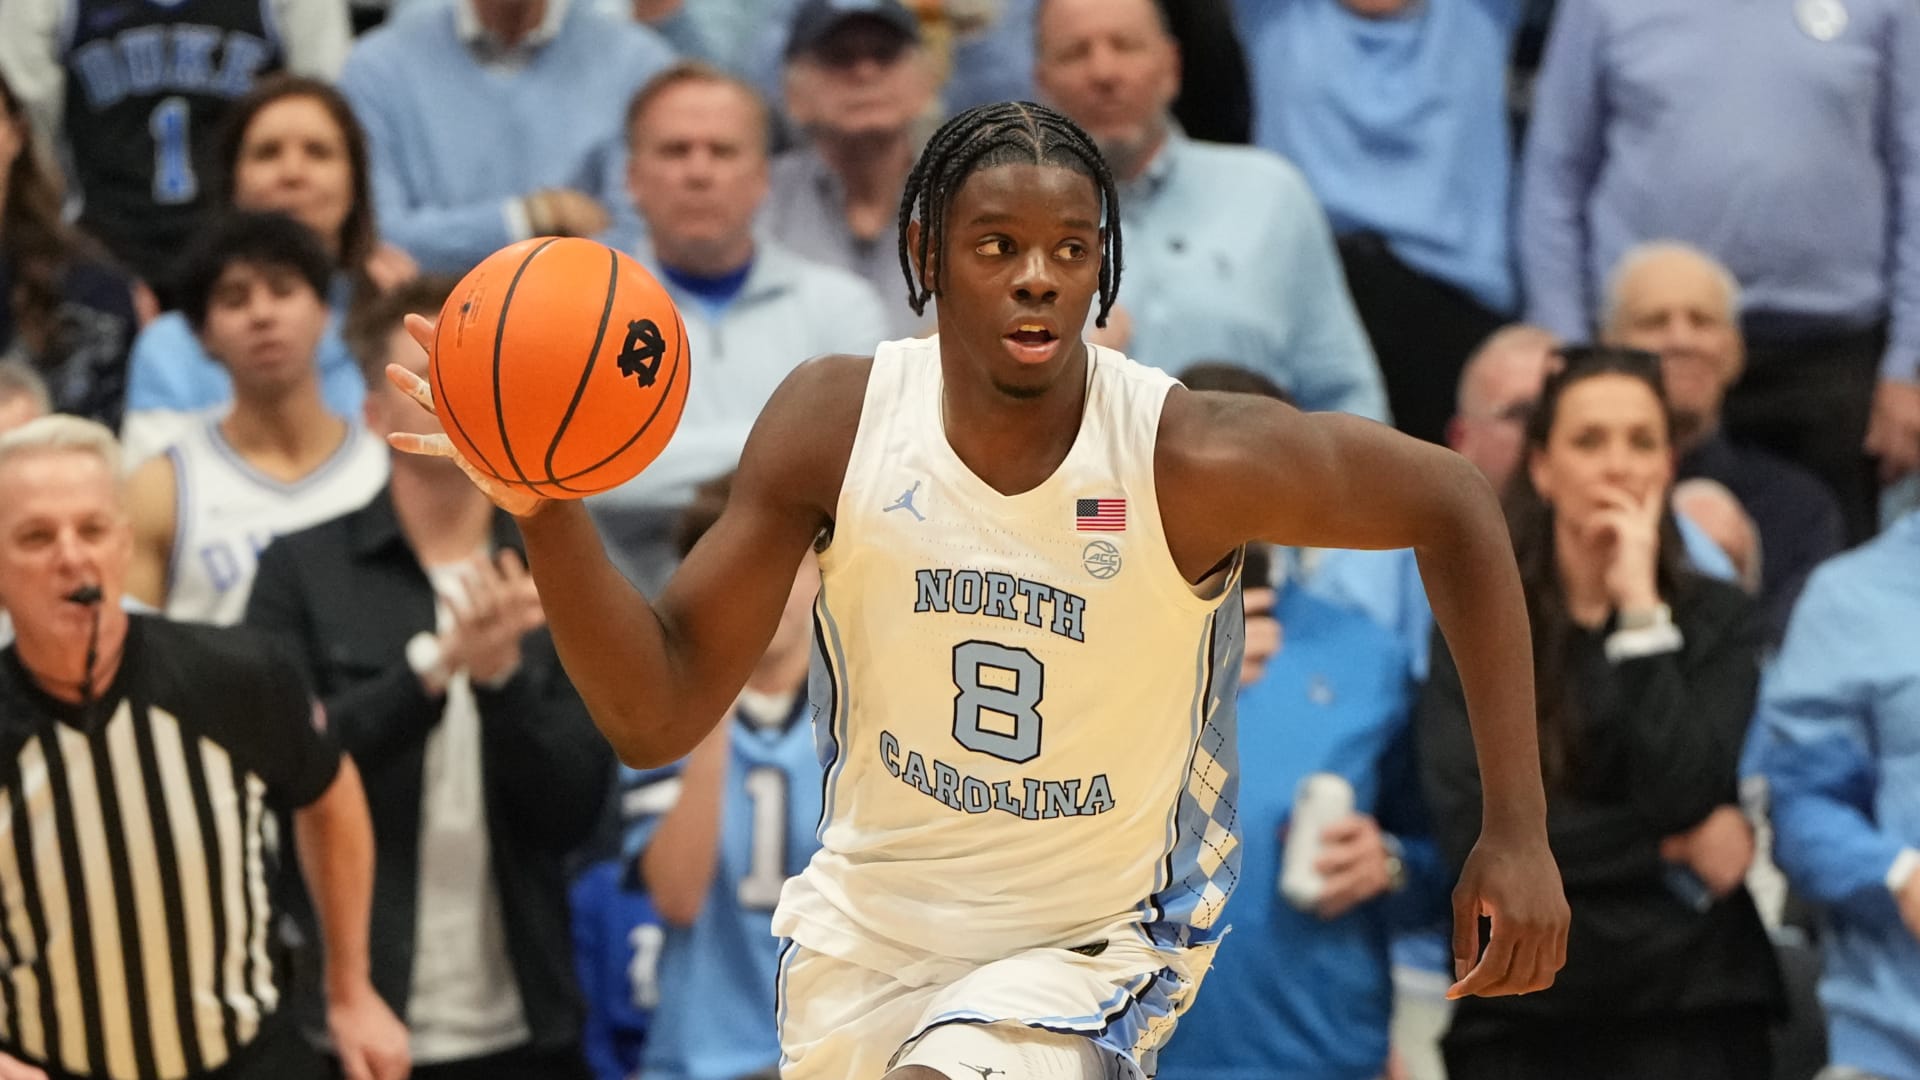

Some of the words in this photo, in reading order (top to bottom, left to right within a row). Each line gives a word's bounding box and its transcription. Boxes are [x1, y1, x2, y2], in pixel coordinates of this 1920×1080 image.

[75, 24, 272, 106] DUKE
[149, 96, 197, 204] 1
[914, 568, 1086, 643] NORTH
[952, 639, 1044, 764] 8
[879, 730, 1115, 820] CAROLINA
[737, 766, 790, 910] 1
